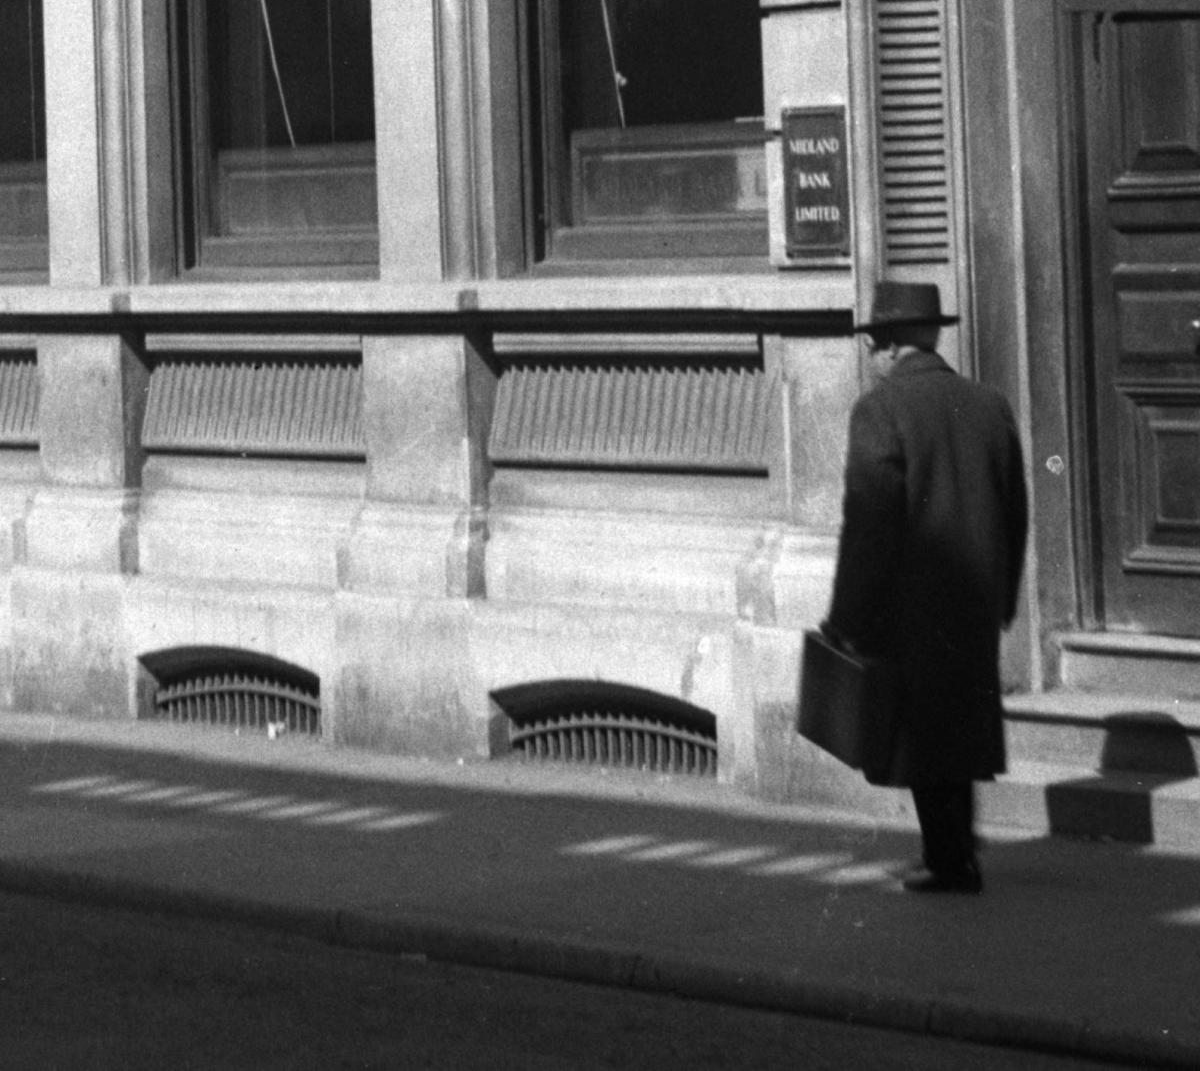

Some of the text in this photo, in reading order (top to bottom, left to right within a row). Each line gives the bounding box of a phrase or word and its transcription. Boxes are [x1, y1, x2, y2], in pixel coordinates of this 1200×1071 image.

[789, 136, 840, 155] MIDLAND
[799, 171, 832, 189] BANK
[794, 204, 841, 223] LIMITED
